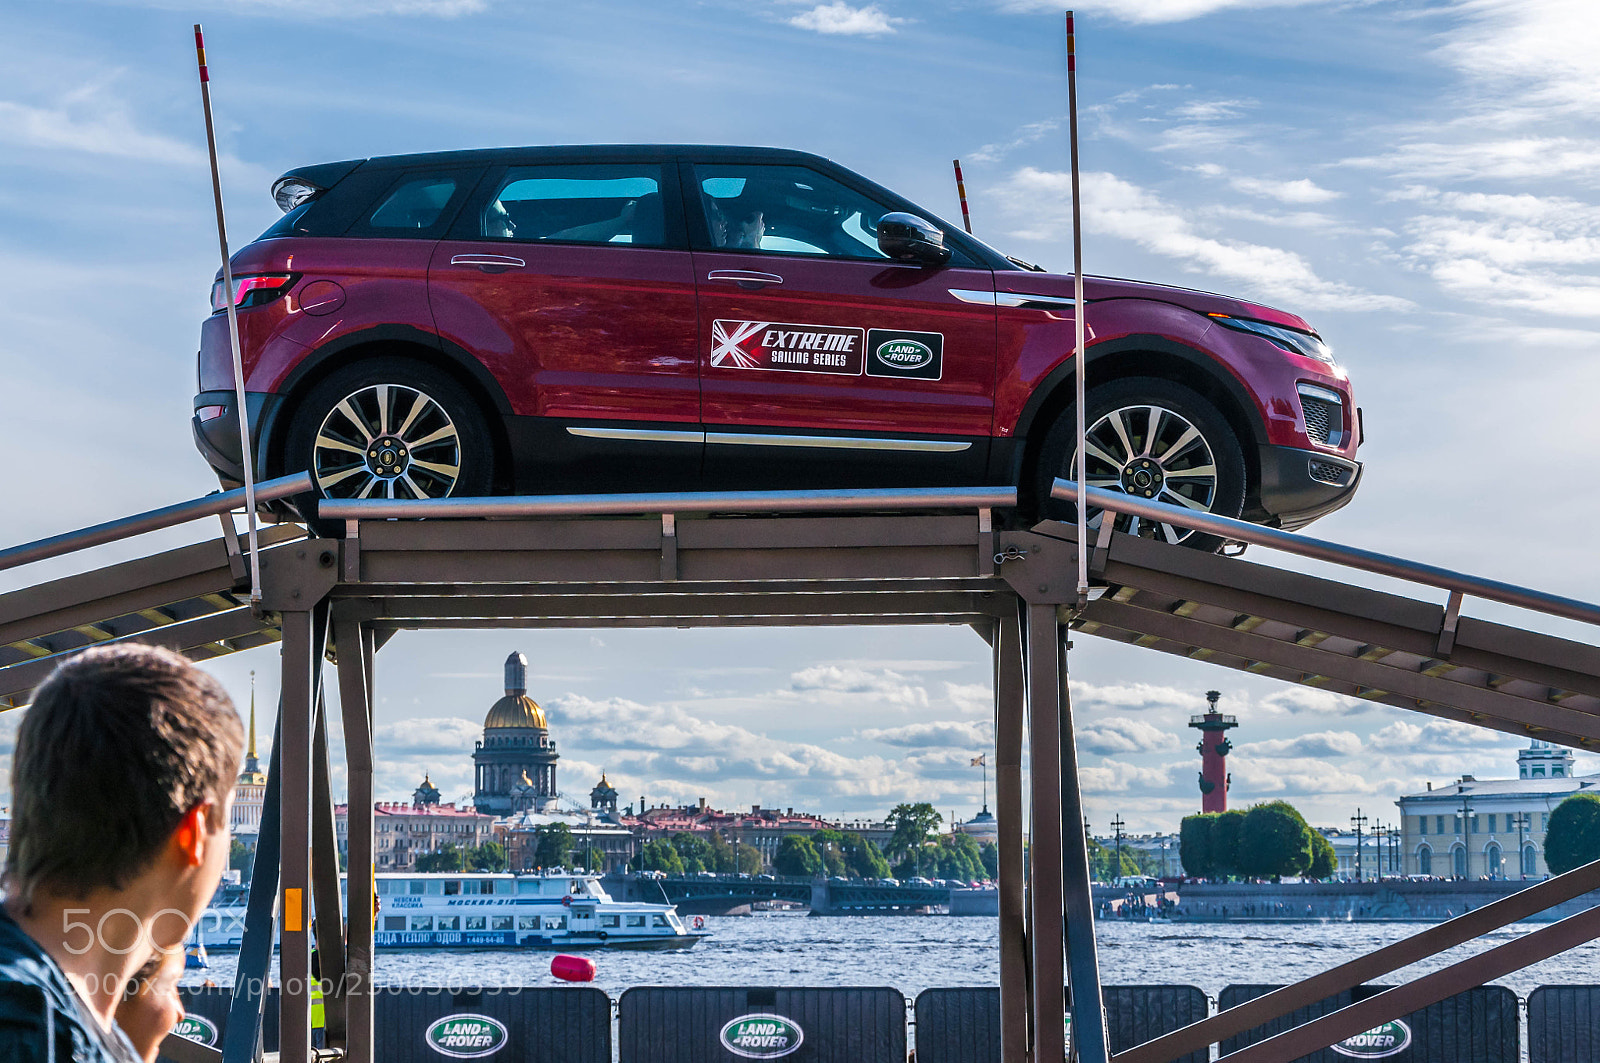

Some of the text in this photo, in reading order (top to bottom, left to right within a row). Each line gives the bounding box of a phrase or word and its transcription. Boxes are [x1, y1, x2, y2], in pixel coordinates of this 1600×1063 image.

[761, 330, 859, 352] EXTREME
[888, 345, 915, 354] LAND
[771, 350, 847, 367] SAILING SERIES
[890, 353, 922, 363] ROVER
[401, 932, 462, 945] ТЕПЛООДОВ
[173, 1022, 192, 1034] ND
[443, 1023, 481, 1035] LAND
[737, 1023, 776, 1035] LAND
[445, 1035, 493, 1047] ROVER
[741, 1036, 788, 1047] ROVER
[1345, 1035, 1395, 1047] ROVER
